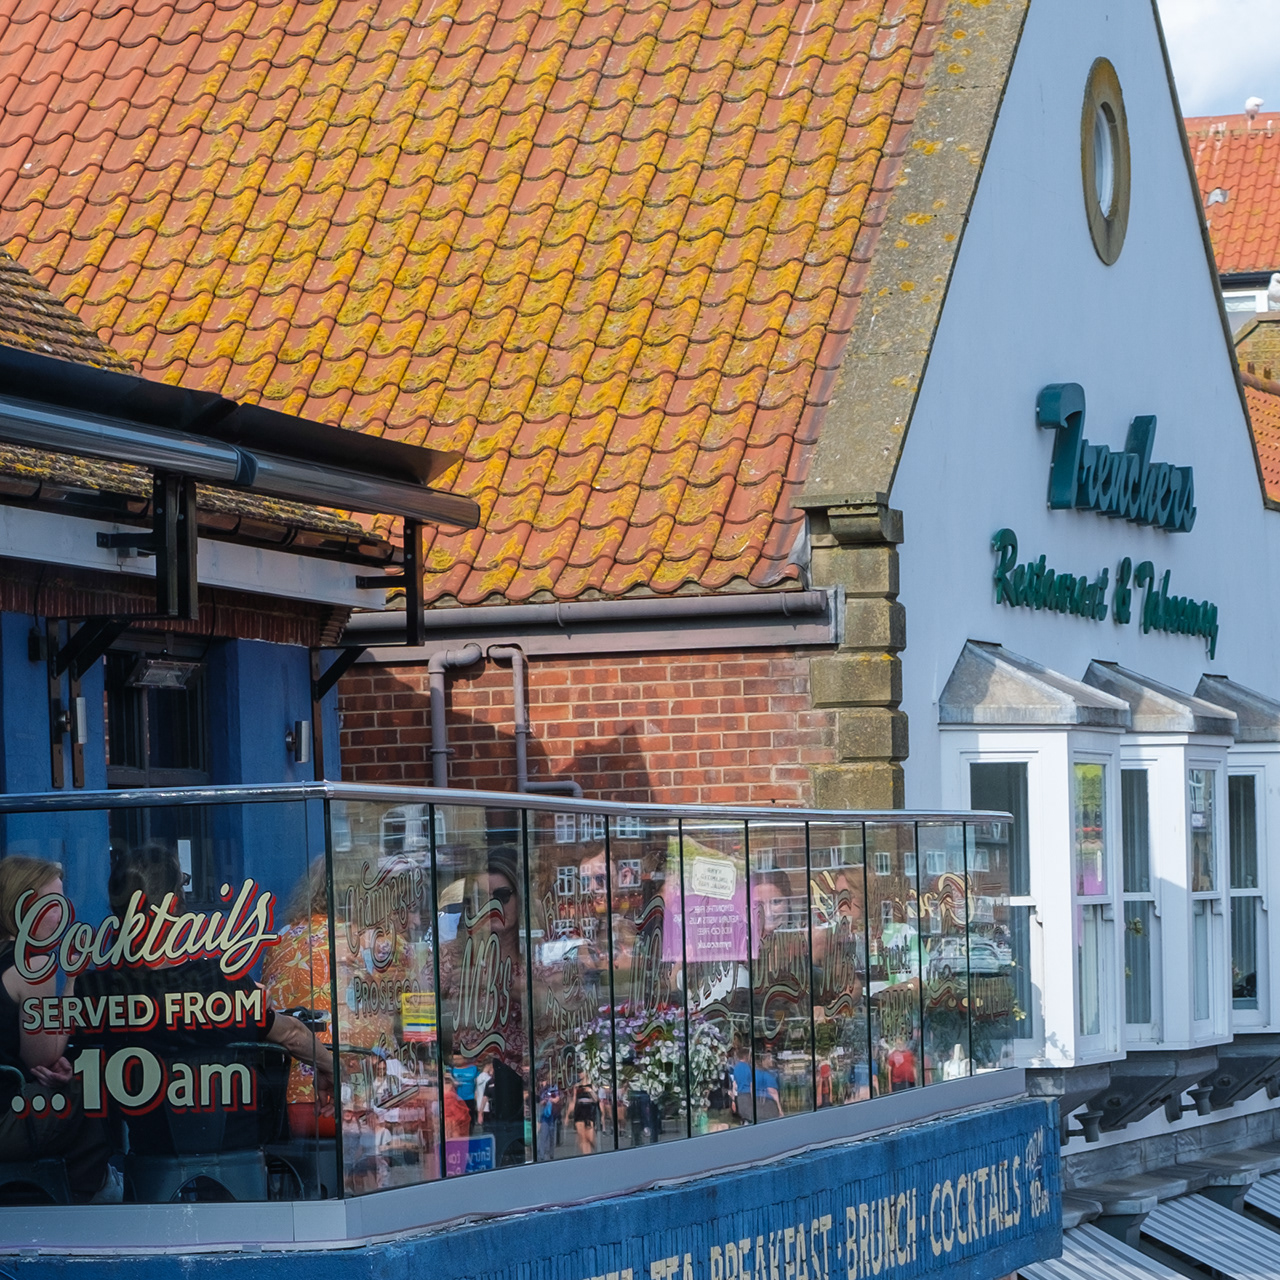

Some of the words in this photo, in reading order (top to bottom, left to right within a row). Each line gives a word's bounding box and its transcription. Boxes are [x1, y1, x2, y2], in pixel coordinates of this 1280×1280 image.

[1036, 382, 1197, 533] Trenchers
[1115, 557, 1132, 624] &
[14, 878, 281, 982] Cocktails
[22, 995, 156, 1033] SERVED
[165, 989, 265, 1028] FROM
[929, 1155, 1021, 1257] COCKTAILS
